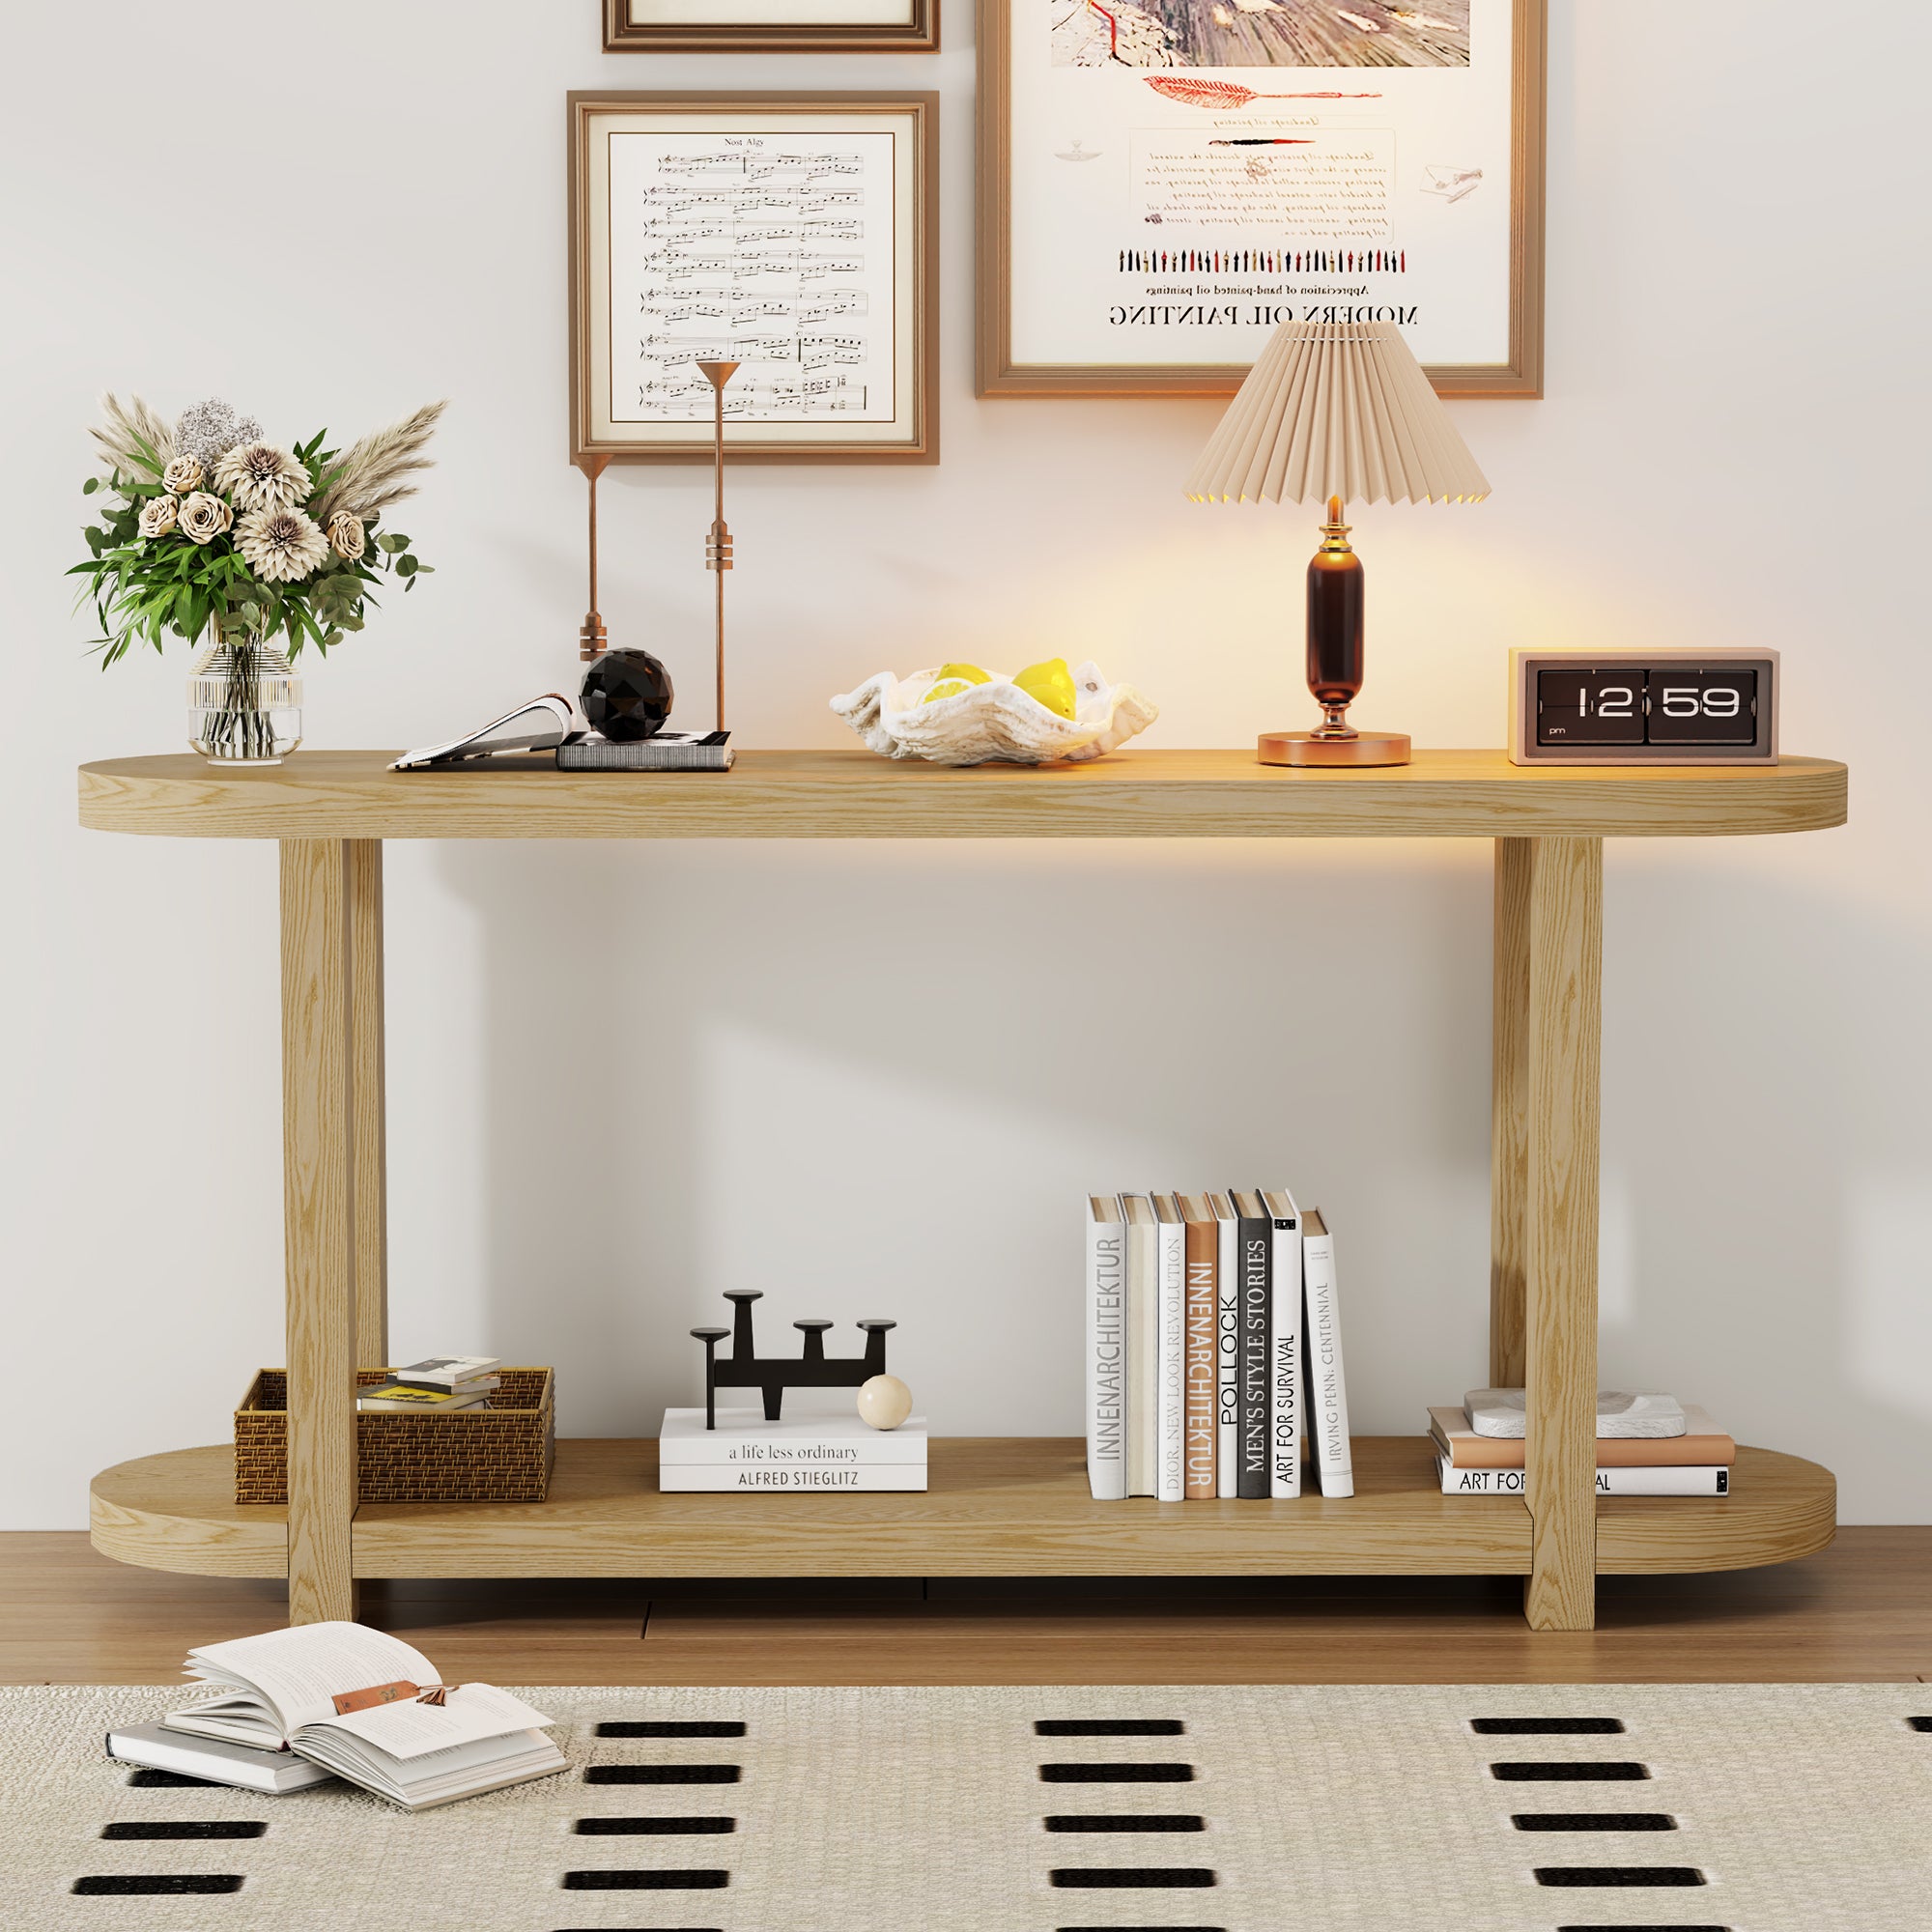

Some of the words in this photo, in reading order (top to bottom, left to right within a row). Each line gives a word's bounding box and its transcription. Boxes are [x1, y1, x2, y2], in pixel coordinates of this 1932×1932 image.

[724, 138, 743, 147] Nost
[747, 138, 765, 148] Algy
[1167, 1237, 1180, 1347] REVOLUTION
[1246, 1239, 1265, 1329] STORIES
[1096, 1237, 1121, 1461] INNENARCHITEKTUR
[1316, 1282, 1334, 1365] CENTENNIAL
[1167, 1351, 1180, 1397] LOOK
[1188, 1262, 1212, 1487] INNENARCHITEKTUR
[1220, 1295, 1237, 1425] POLLOCK
[1246, 1334, 1265, 1402] STYLE
[1276, 1334, 1294, 1408] SURVIVAL
[1323, 1369, 1338, 1407] PENN:
[1167, 1403, 1179, 1439] NEW
[1246, 1406, 1264, 1473] MEN'S
[1276, 1413, 1293, 1447] FOR
[1326, 1411, 1343, 1462] IRVING
[729, 1449, 737, 1460] a
[742, 1444, 764, 1459] life
[769, 1444, 793, 1459] less
[797, 1444, 859, 1463] ordinary
[738, 1471, 788, 1485] ALFRED
[793, 1471, 859, 1485] STIEGLITZ
[1276, 1454, 1293, 1484] ART
[1460, 1472, 1491, 1490] ART
